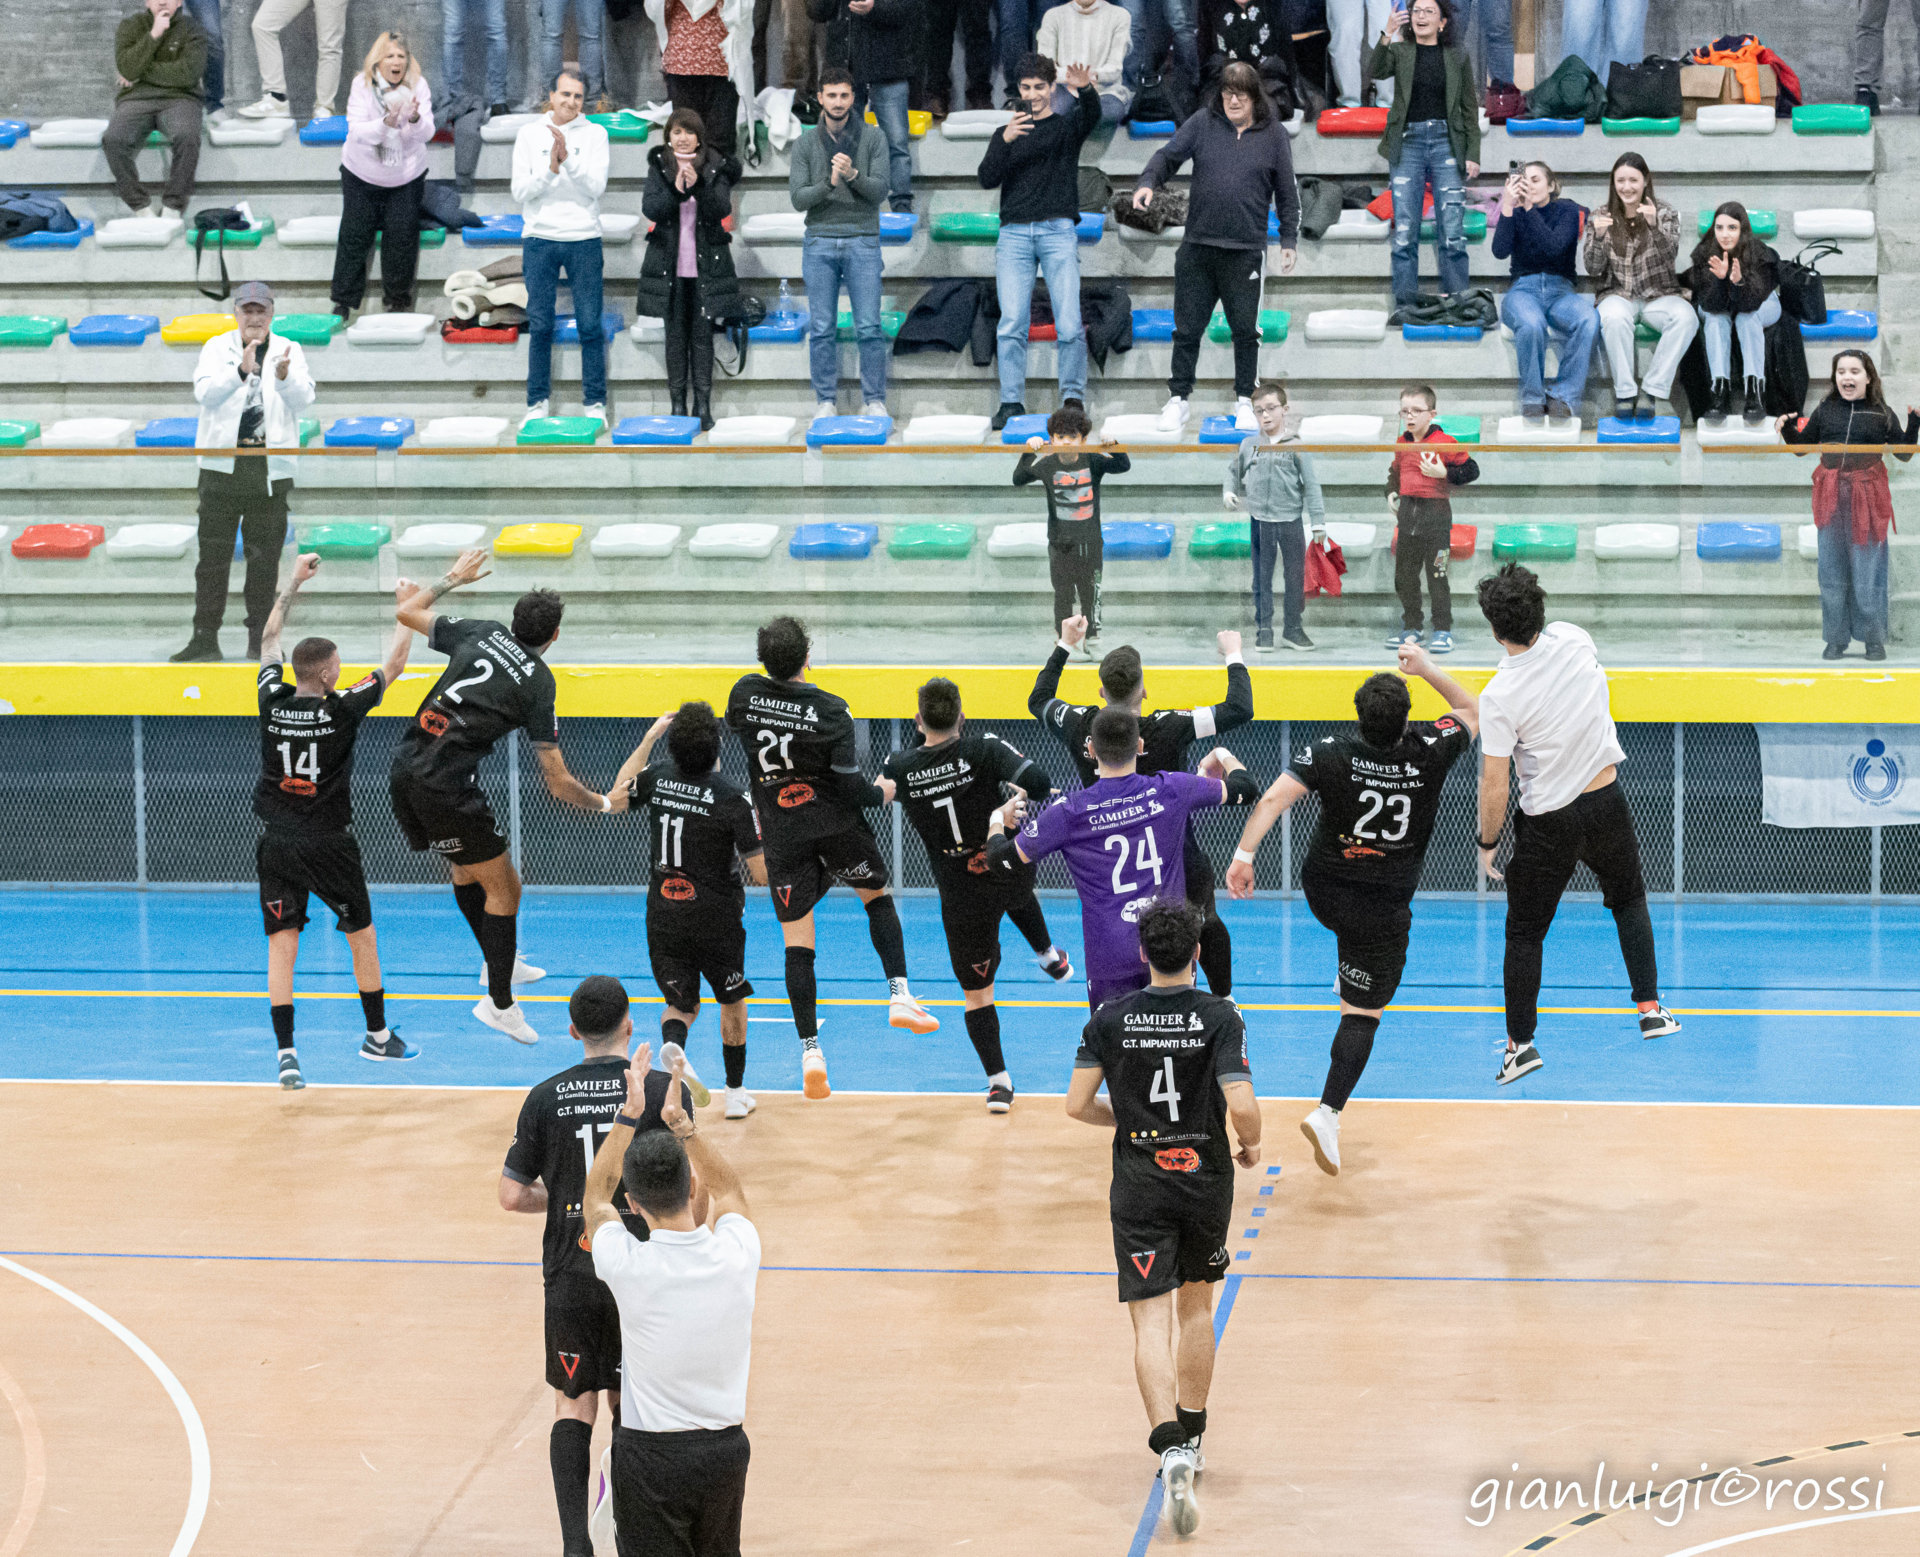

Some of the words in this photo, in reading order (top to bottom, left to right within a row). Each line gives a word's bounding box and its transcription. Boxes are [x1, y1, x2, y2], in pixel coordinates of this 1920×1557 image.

[492, 631, 527, 662] GAMIFER
[445, 658, 494, 704] 2
[749, 695, 802, 714] GAMIFER
[271, 708, 315, 720] GAMIFER
[746, 714, 759, 723] C.T.
[760, 717, 794, 730] IMPIANTI
[281, 728, 313, 737] IMPIANTI
[756, 729, 794, 773] 21
[276, 741, 321, 784] 14
[1352, 757, 1401, 774] GAMIFER
[907, 762, 955, 782] GAMIFER
[656, 778, 701, 796] GAMIFER
[910, 790, 923, 799] C.T.
[923, 782, 956, 797] IMPIANTI
[1365, 779, 1400, 789] IMPIANTI
[661, 799, 691, 812] IMPIANTI
[1088, 804, 1145, 825] GAMIFER
[932, 796, 963, 845] 7
[1353, 789, 1412, 841] 23
[659, 813, 684, 867] 11
[1104, 825, 1164, 895] 24
[1123, 1013, 1184, 1026] GAMIFER
[1123, 1039, 1139, 1048] C.T.
[1140, 1039, 1180, 1048] IMPIANTI
[556, 1079, 622, 1093] GAMIFER
[564, 1092, 589, 1100] Gamillo
[589, 1090, 624, 1098] Alessandro
[1149, 1056, 1181, 1122] 4
[557, 1106, 573, 1117] C.T.
[574, 1104, 618, 1114] IMPIANTI
